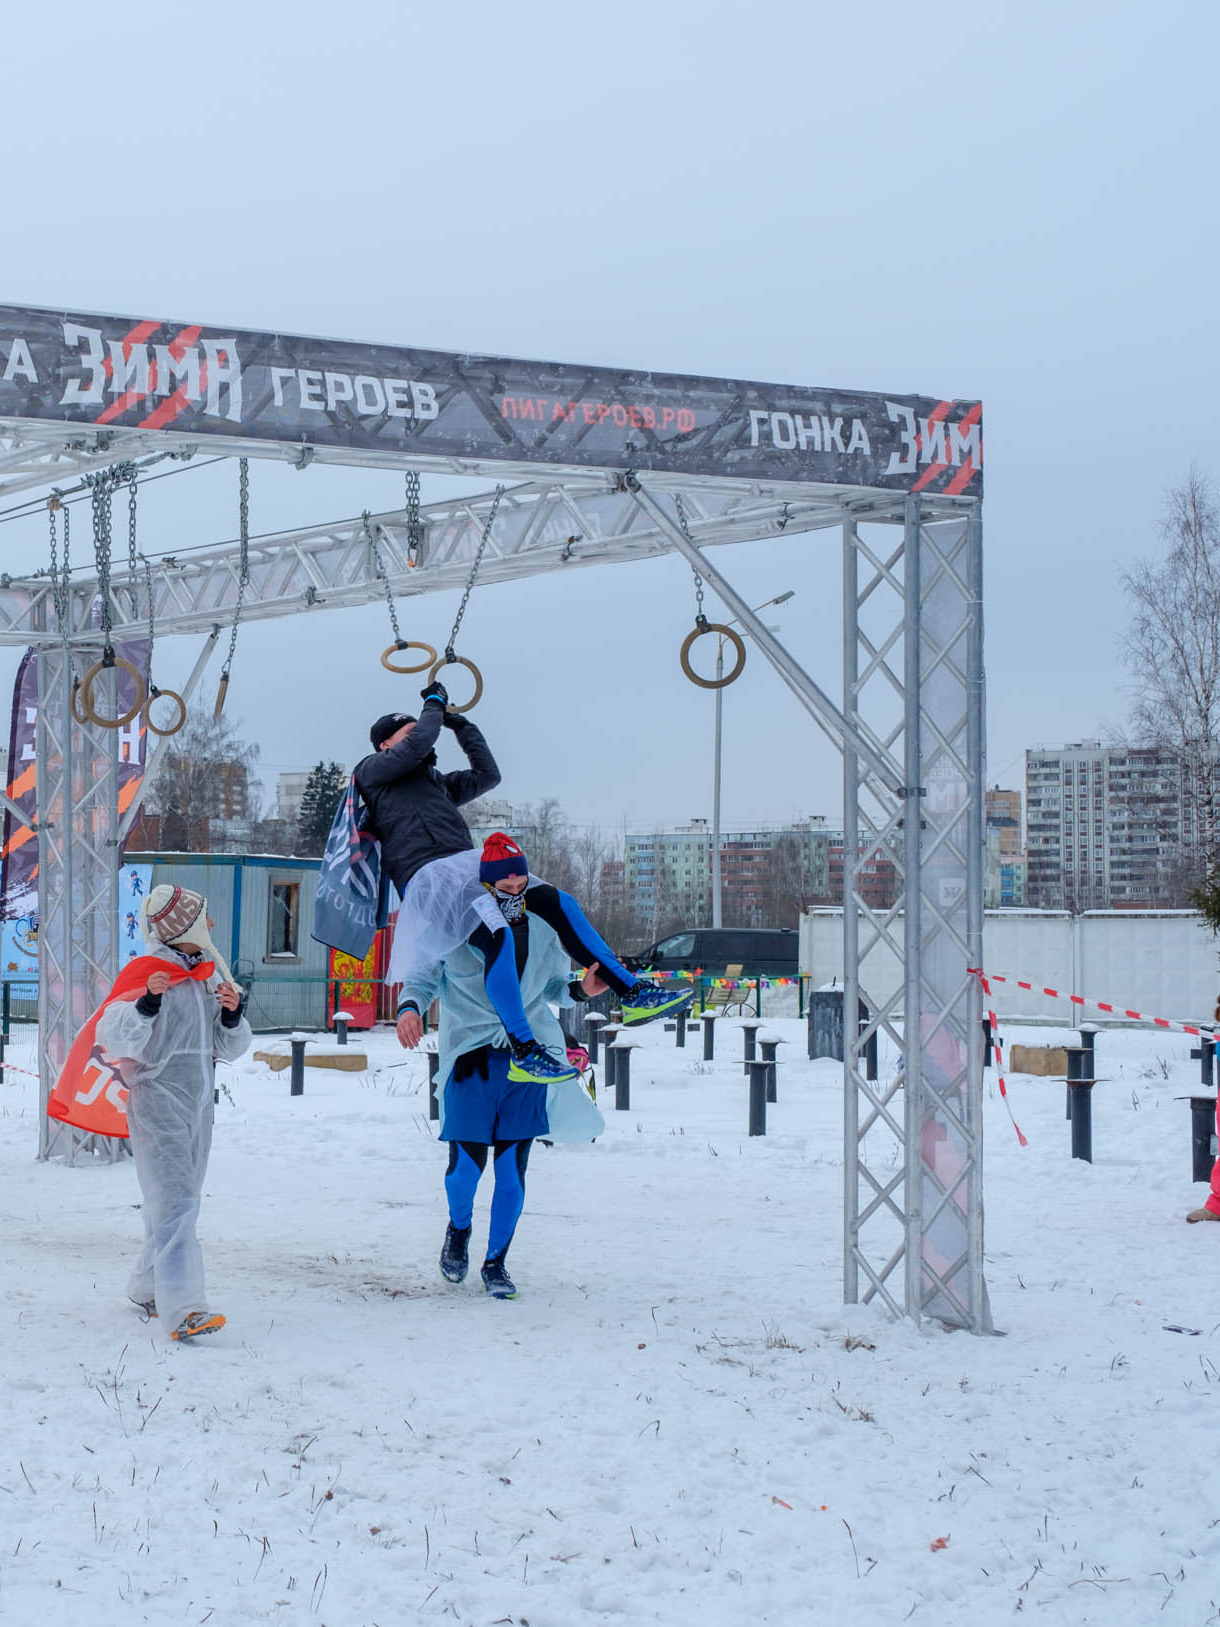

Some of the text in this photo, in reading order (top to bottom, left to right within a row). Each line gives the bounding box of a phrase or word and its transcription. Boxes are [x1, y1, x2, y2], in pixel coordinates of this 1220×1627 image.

[59, 322, 243, 423] ЗИМА
[271, 366, 440, 420] ГЕРОЕВ
[749, 409, 871, 456] ГОНКА
